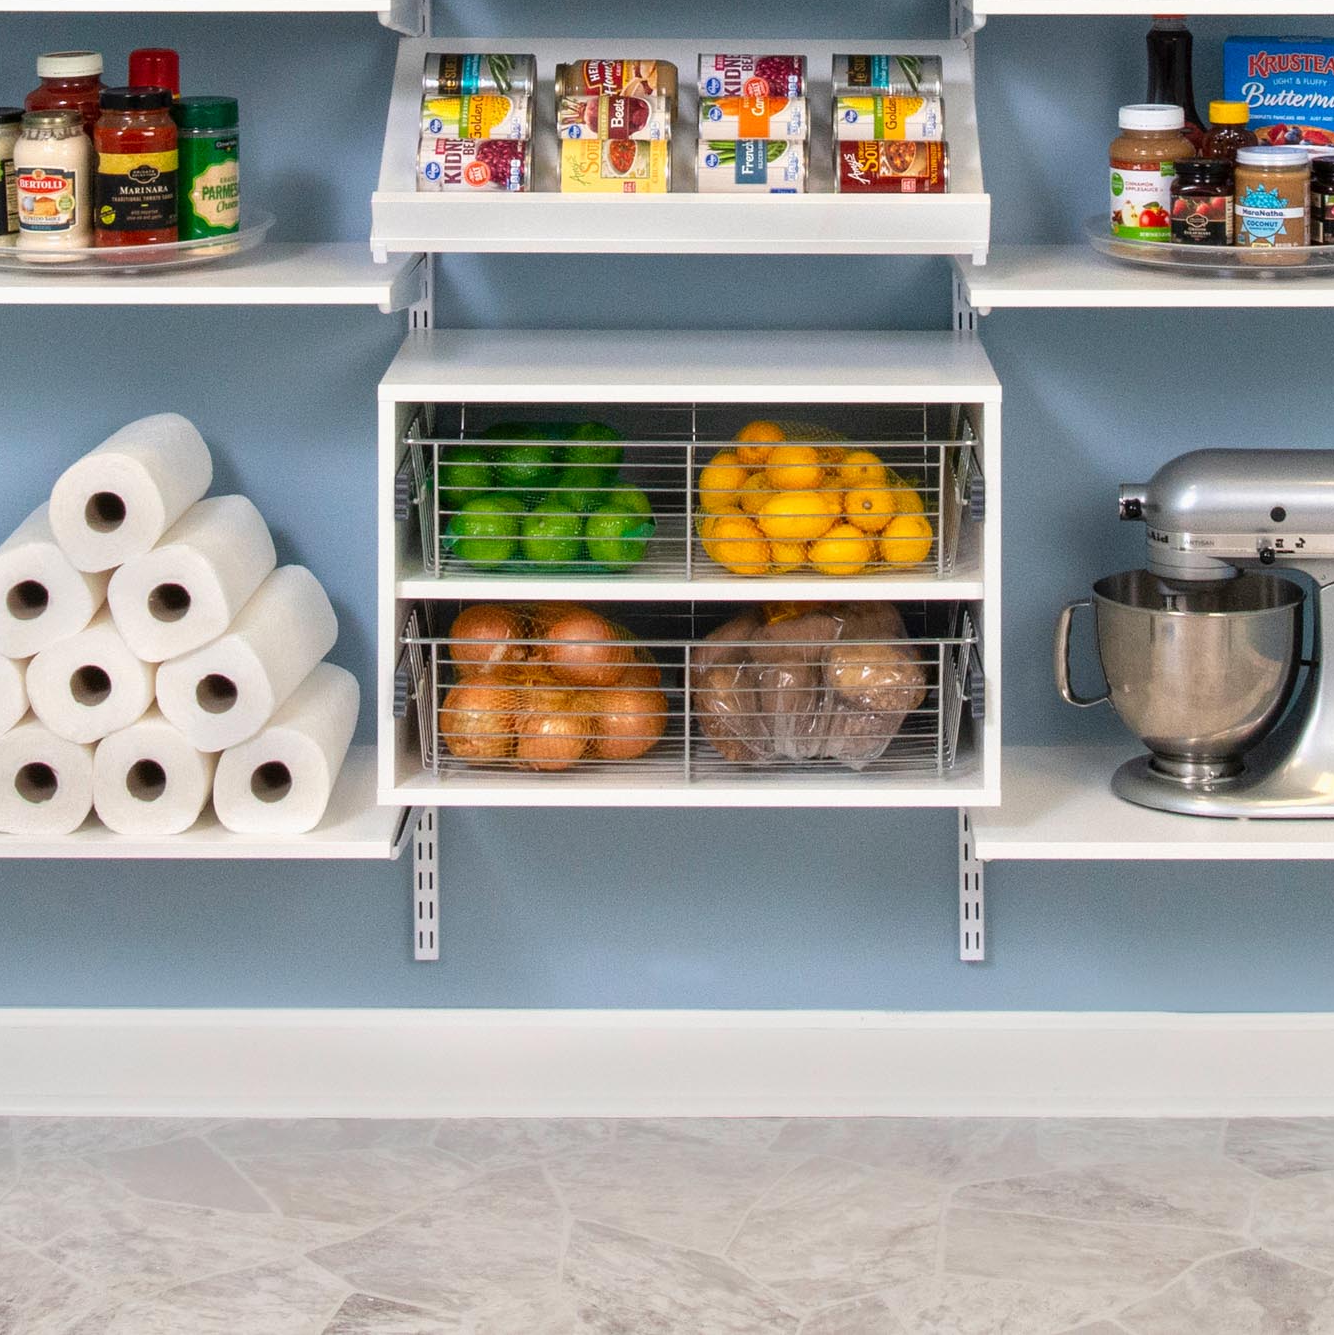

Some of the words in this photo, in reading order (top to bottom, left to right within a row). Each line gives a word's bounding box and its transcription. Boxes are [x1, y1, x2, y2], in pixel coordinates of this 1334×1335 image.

[588, 60, 601, 82] HEIN
[1272, 77, 1294, 86] LIGHT
[1303, 77, 1329, 87] FLUFFY
[611, 98, 625, 128] Beets
[843, 153, 871, 185] Amy's
[19, 178, 63, 189] BERTOLLI
[119, 185, 169, 195] MARINARA
[1242, 208, 1285, 217] MaraNatha
[1246, 219, 1279, 228] COCONUT
[1149, 531, 1169, 544] Aid
